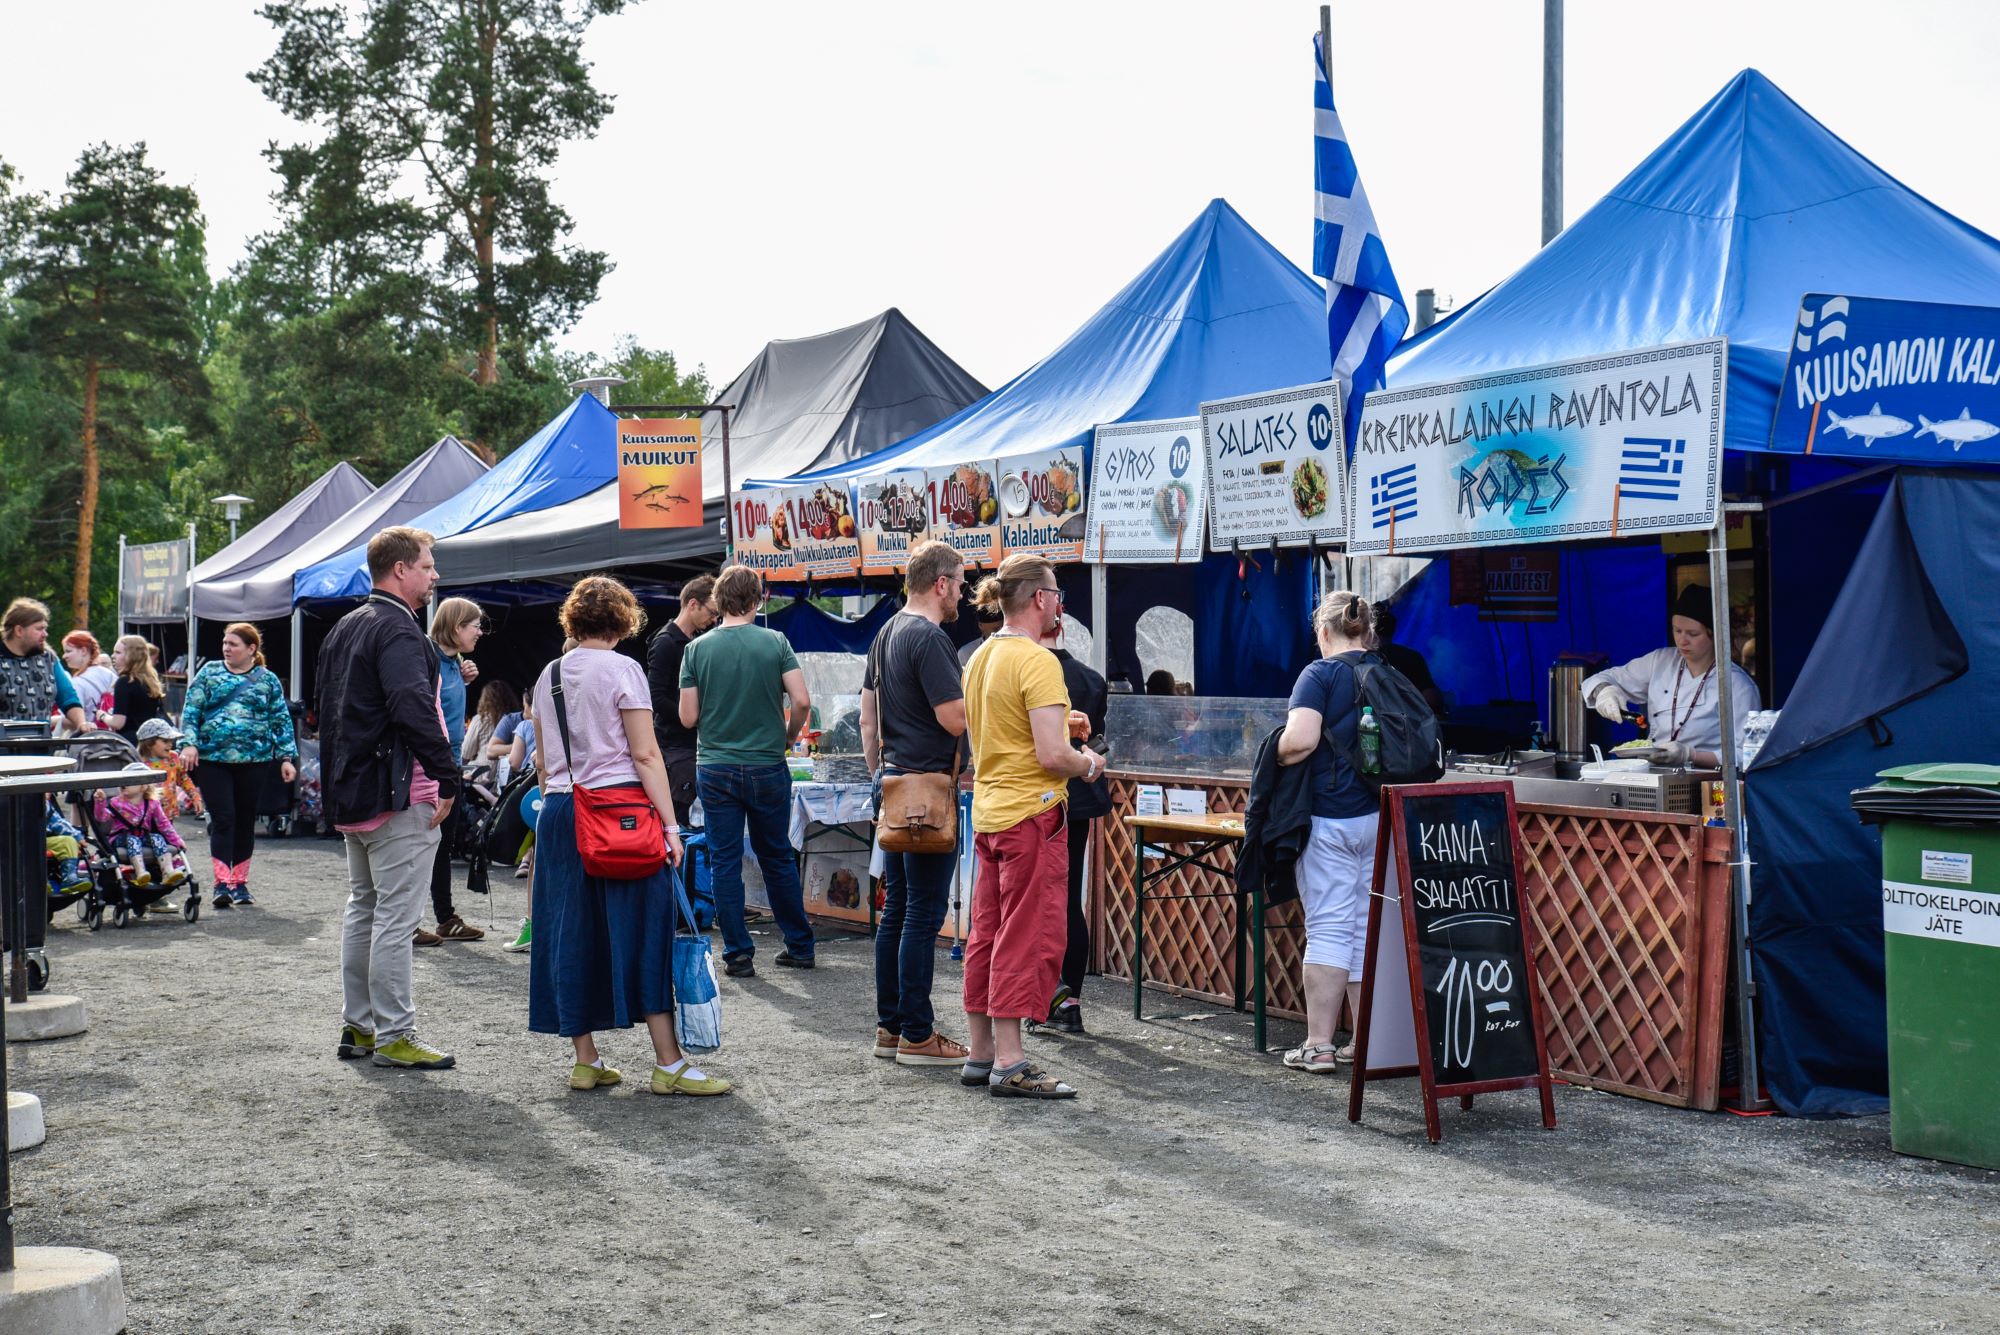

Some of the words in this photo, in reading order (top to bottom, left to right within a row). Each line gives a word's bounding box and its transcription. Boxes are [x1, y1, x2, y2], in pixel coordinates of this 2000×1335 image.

[1795, 336, 1945, 409] KUUSAMON
[1363, 394, 1535, 455] KREIKKALAINEN
[1548, 371, 1702, 431] RAVINTOLA
[622, 433, 697, 444] Kuusamon
[1216, 411, 1298, 459] SALATES
[622, 450, 698, 466] MUIKUT
[1105, 446, 1156, 484] GYROS
[877, 533, 907, 551] Muikku
[793, 544, 858, 563] Muikkulautanen
[1487, 571, 1552, 592] HAKOFEST
[1414, 875, 1512, 911] SALAATTI
[1924, 914, 1963, 935] JÄTE
